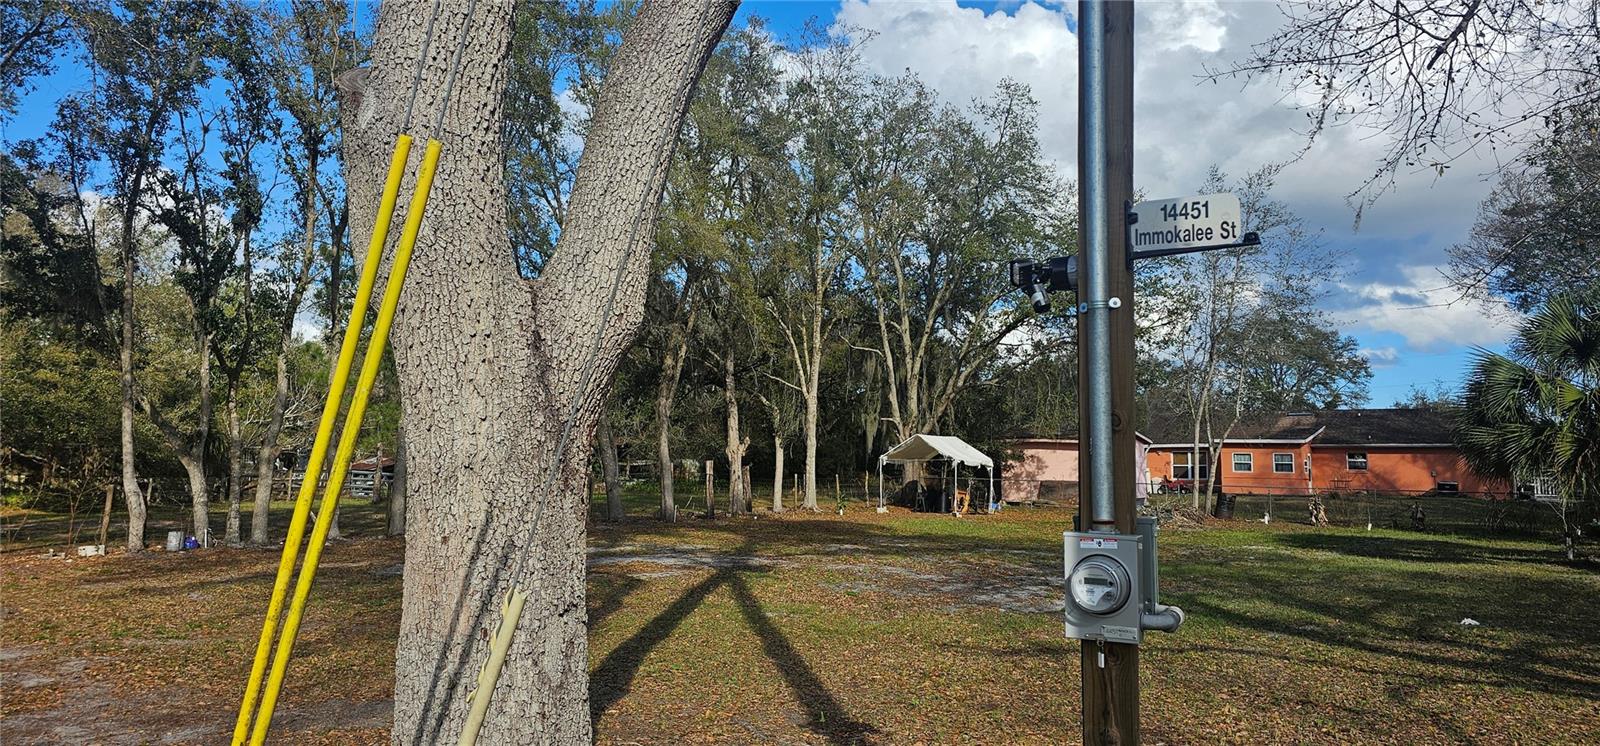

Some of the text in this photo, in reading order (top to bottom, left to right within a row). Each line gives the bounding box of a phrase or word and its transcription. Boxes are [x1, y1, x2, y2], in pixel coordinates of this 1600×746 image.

[1160, 200, 1209, 222] 14451
[1135, 221, 1237, 246] Immokalee St
